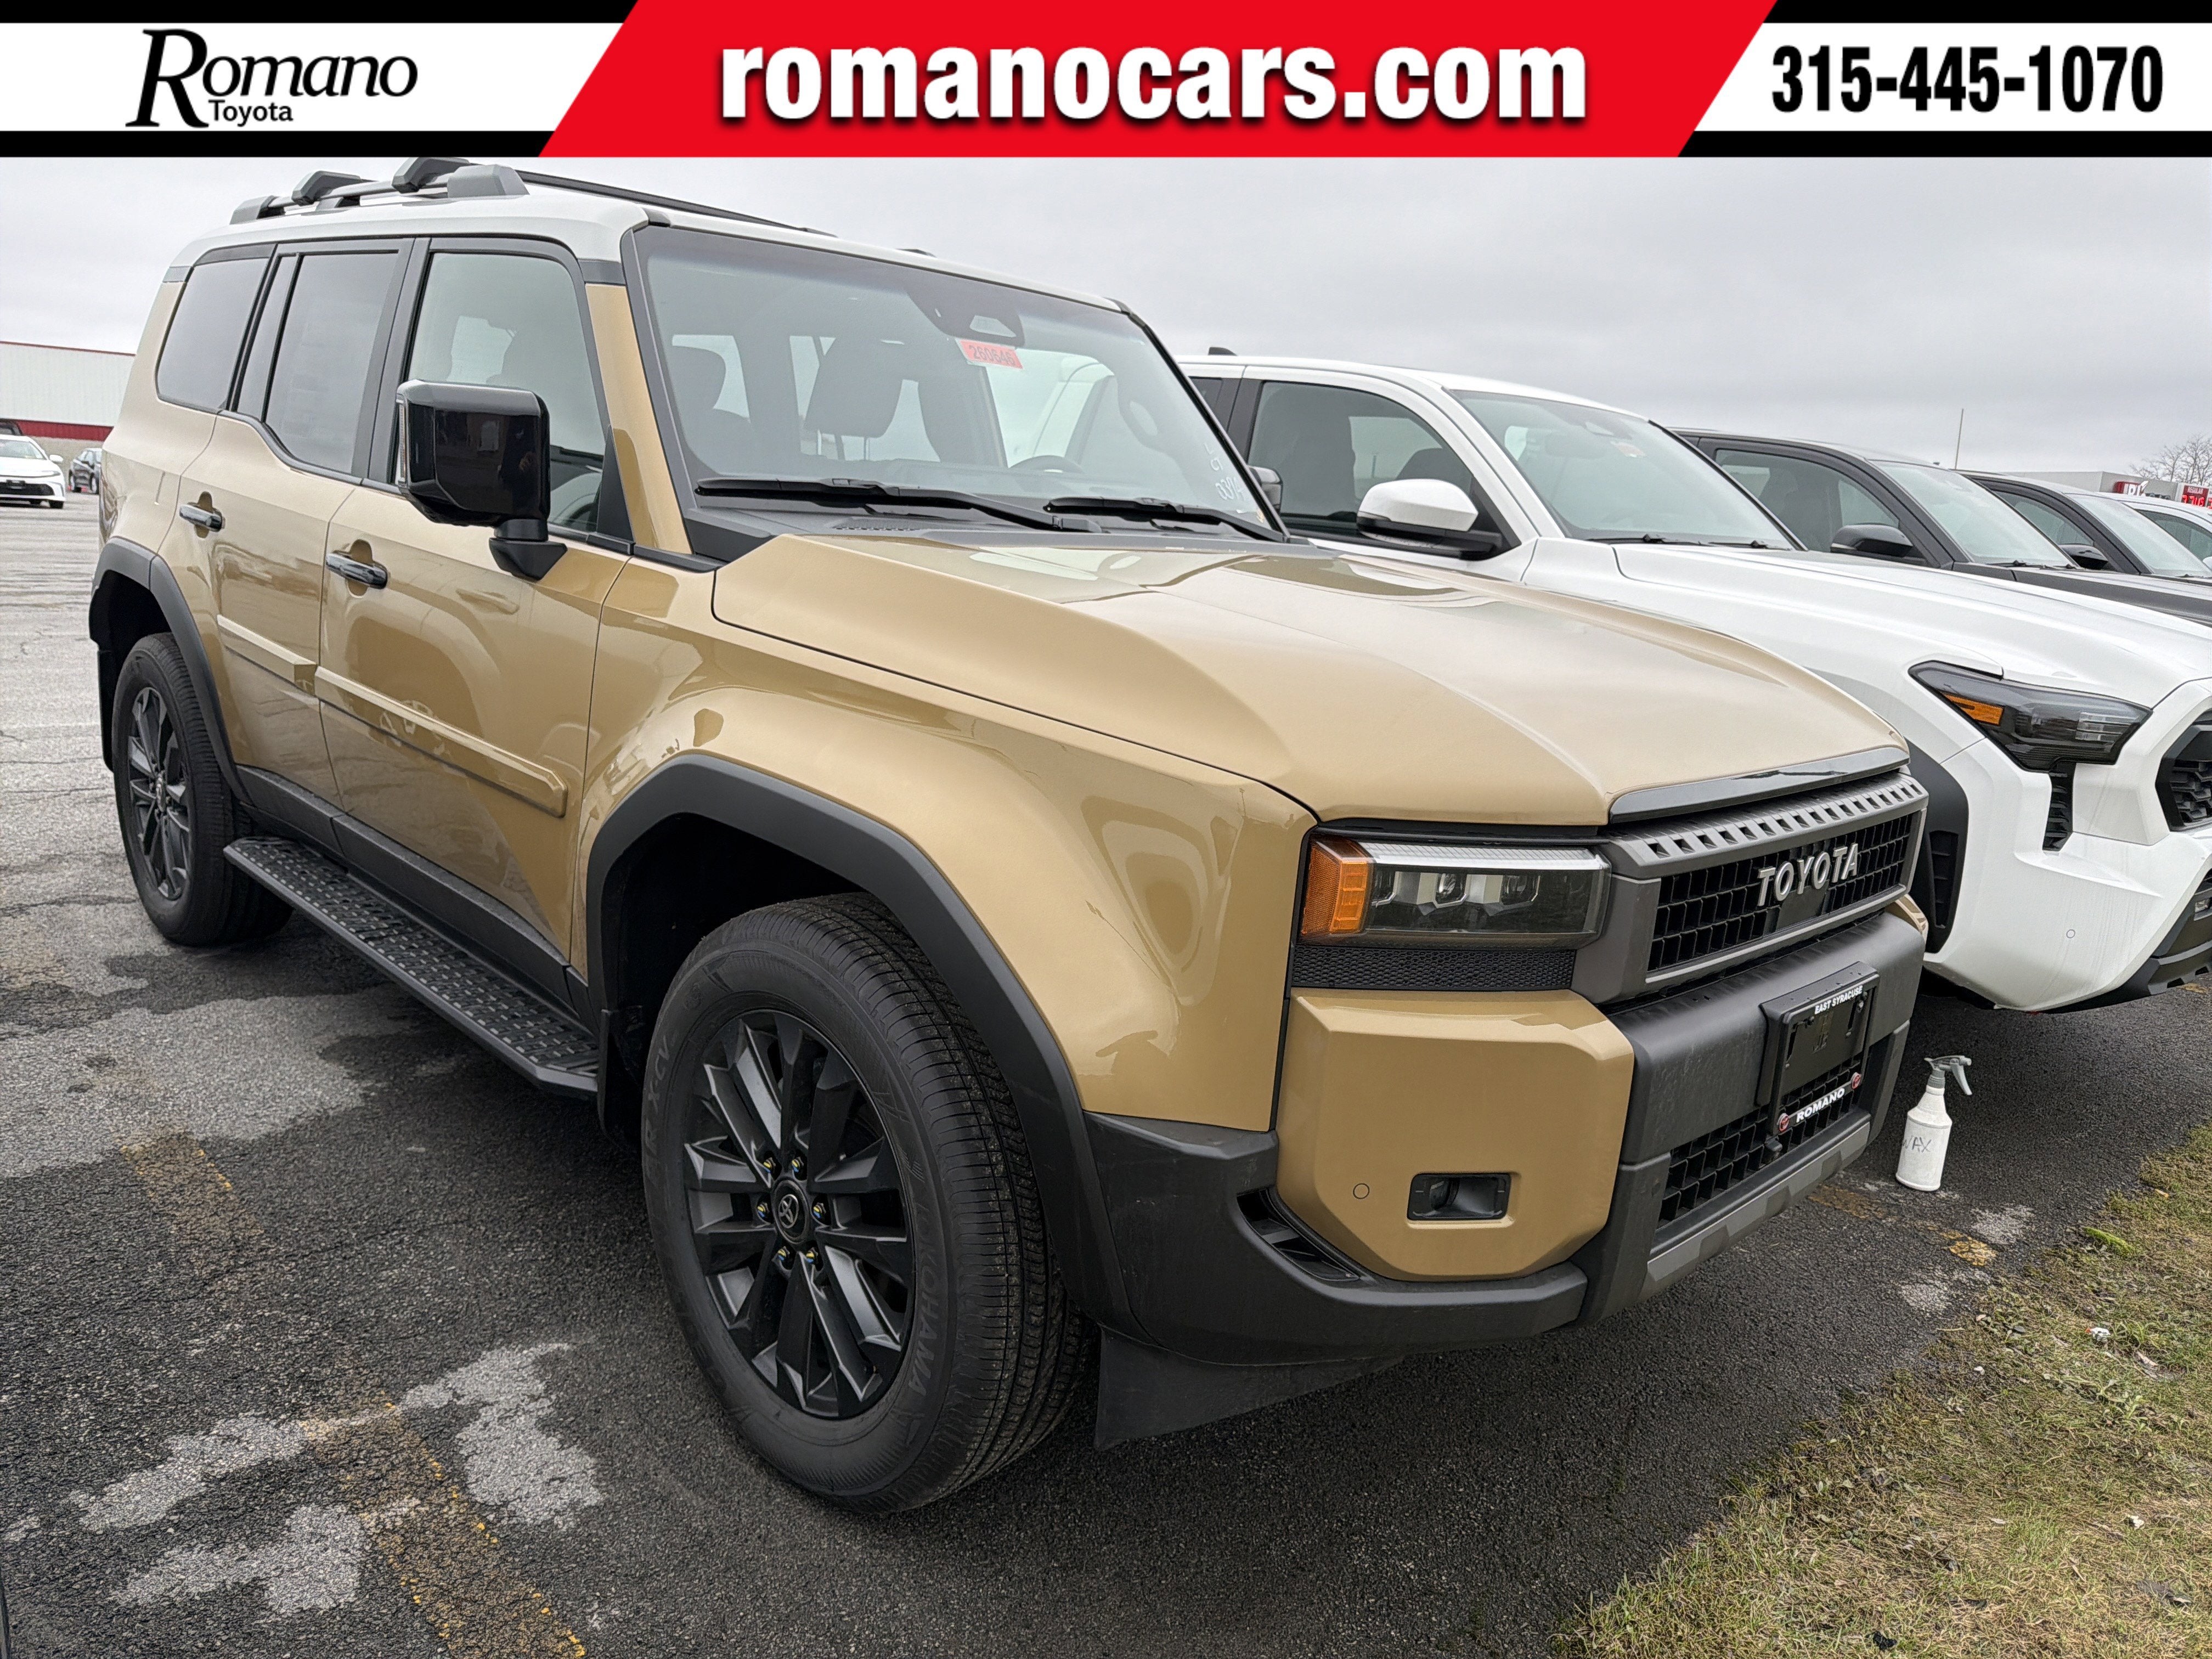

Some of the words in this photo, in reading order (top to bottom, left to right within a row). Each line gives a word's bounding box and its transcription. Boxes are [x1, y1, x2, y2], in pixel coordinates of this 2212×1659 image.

[1757, 842, 1859, 906] TOYOTA
[1814, 1000, 1832, 1015] EAST
[1831, 985, 1863, 1007] SYRACUSE
[1796, 1087, 1846, 1123] ROMANO
